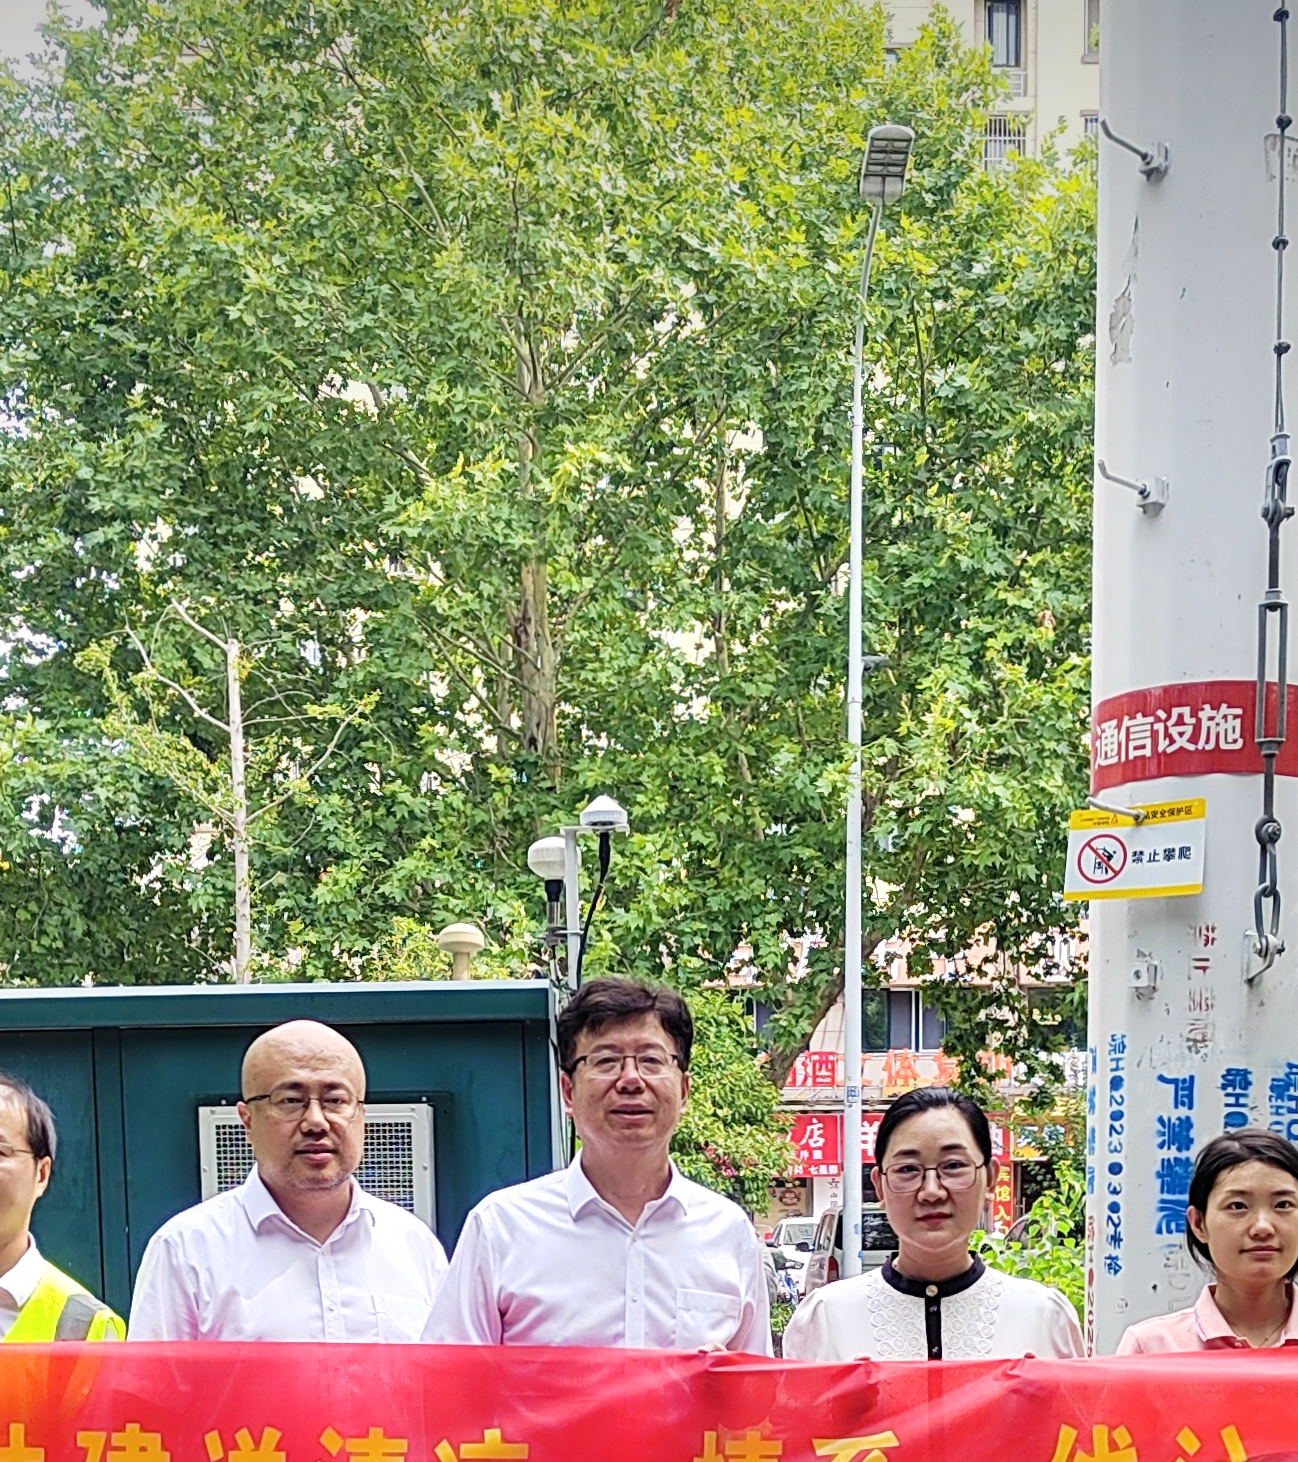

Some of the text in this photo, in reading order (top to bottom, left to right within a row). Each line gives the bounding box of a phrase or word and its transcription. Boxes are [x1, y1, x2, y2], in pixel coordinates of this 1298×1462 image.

[1095, 703, 1244, 769] 通信设施
[1131, 845, 1192, 865] 禁止攀爬
